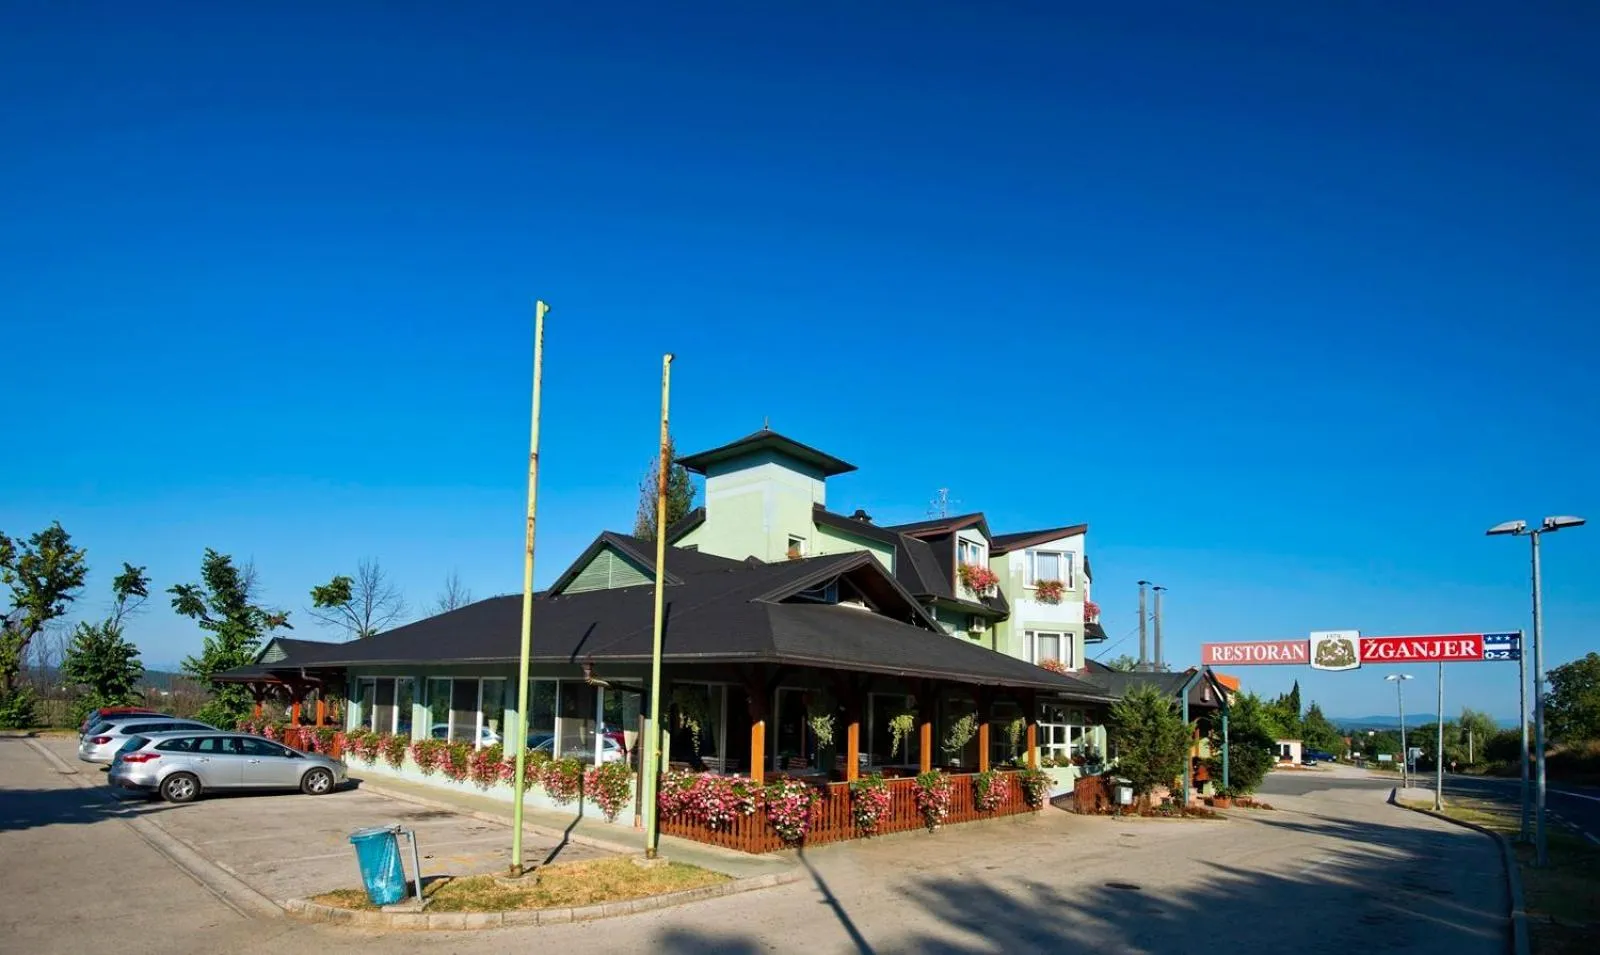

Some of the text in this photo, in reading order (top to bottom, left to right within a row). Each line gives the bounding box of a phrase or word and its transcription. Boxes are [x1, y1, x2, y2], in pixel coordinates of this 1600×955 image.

[1211, 639, 1478, 662] RESTORAN ŽGANJER
[1484, 651, 1520, 660] 0-2
